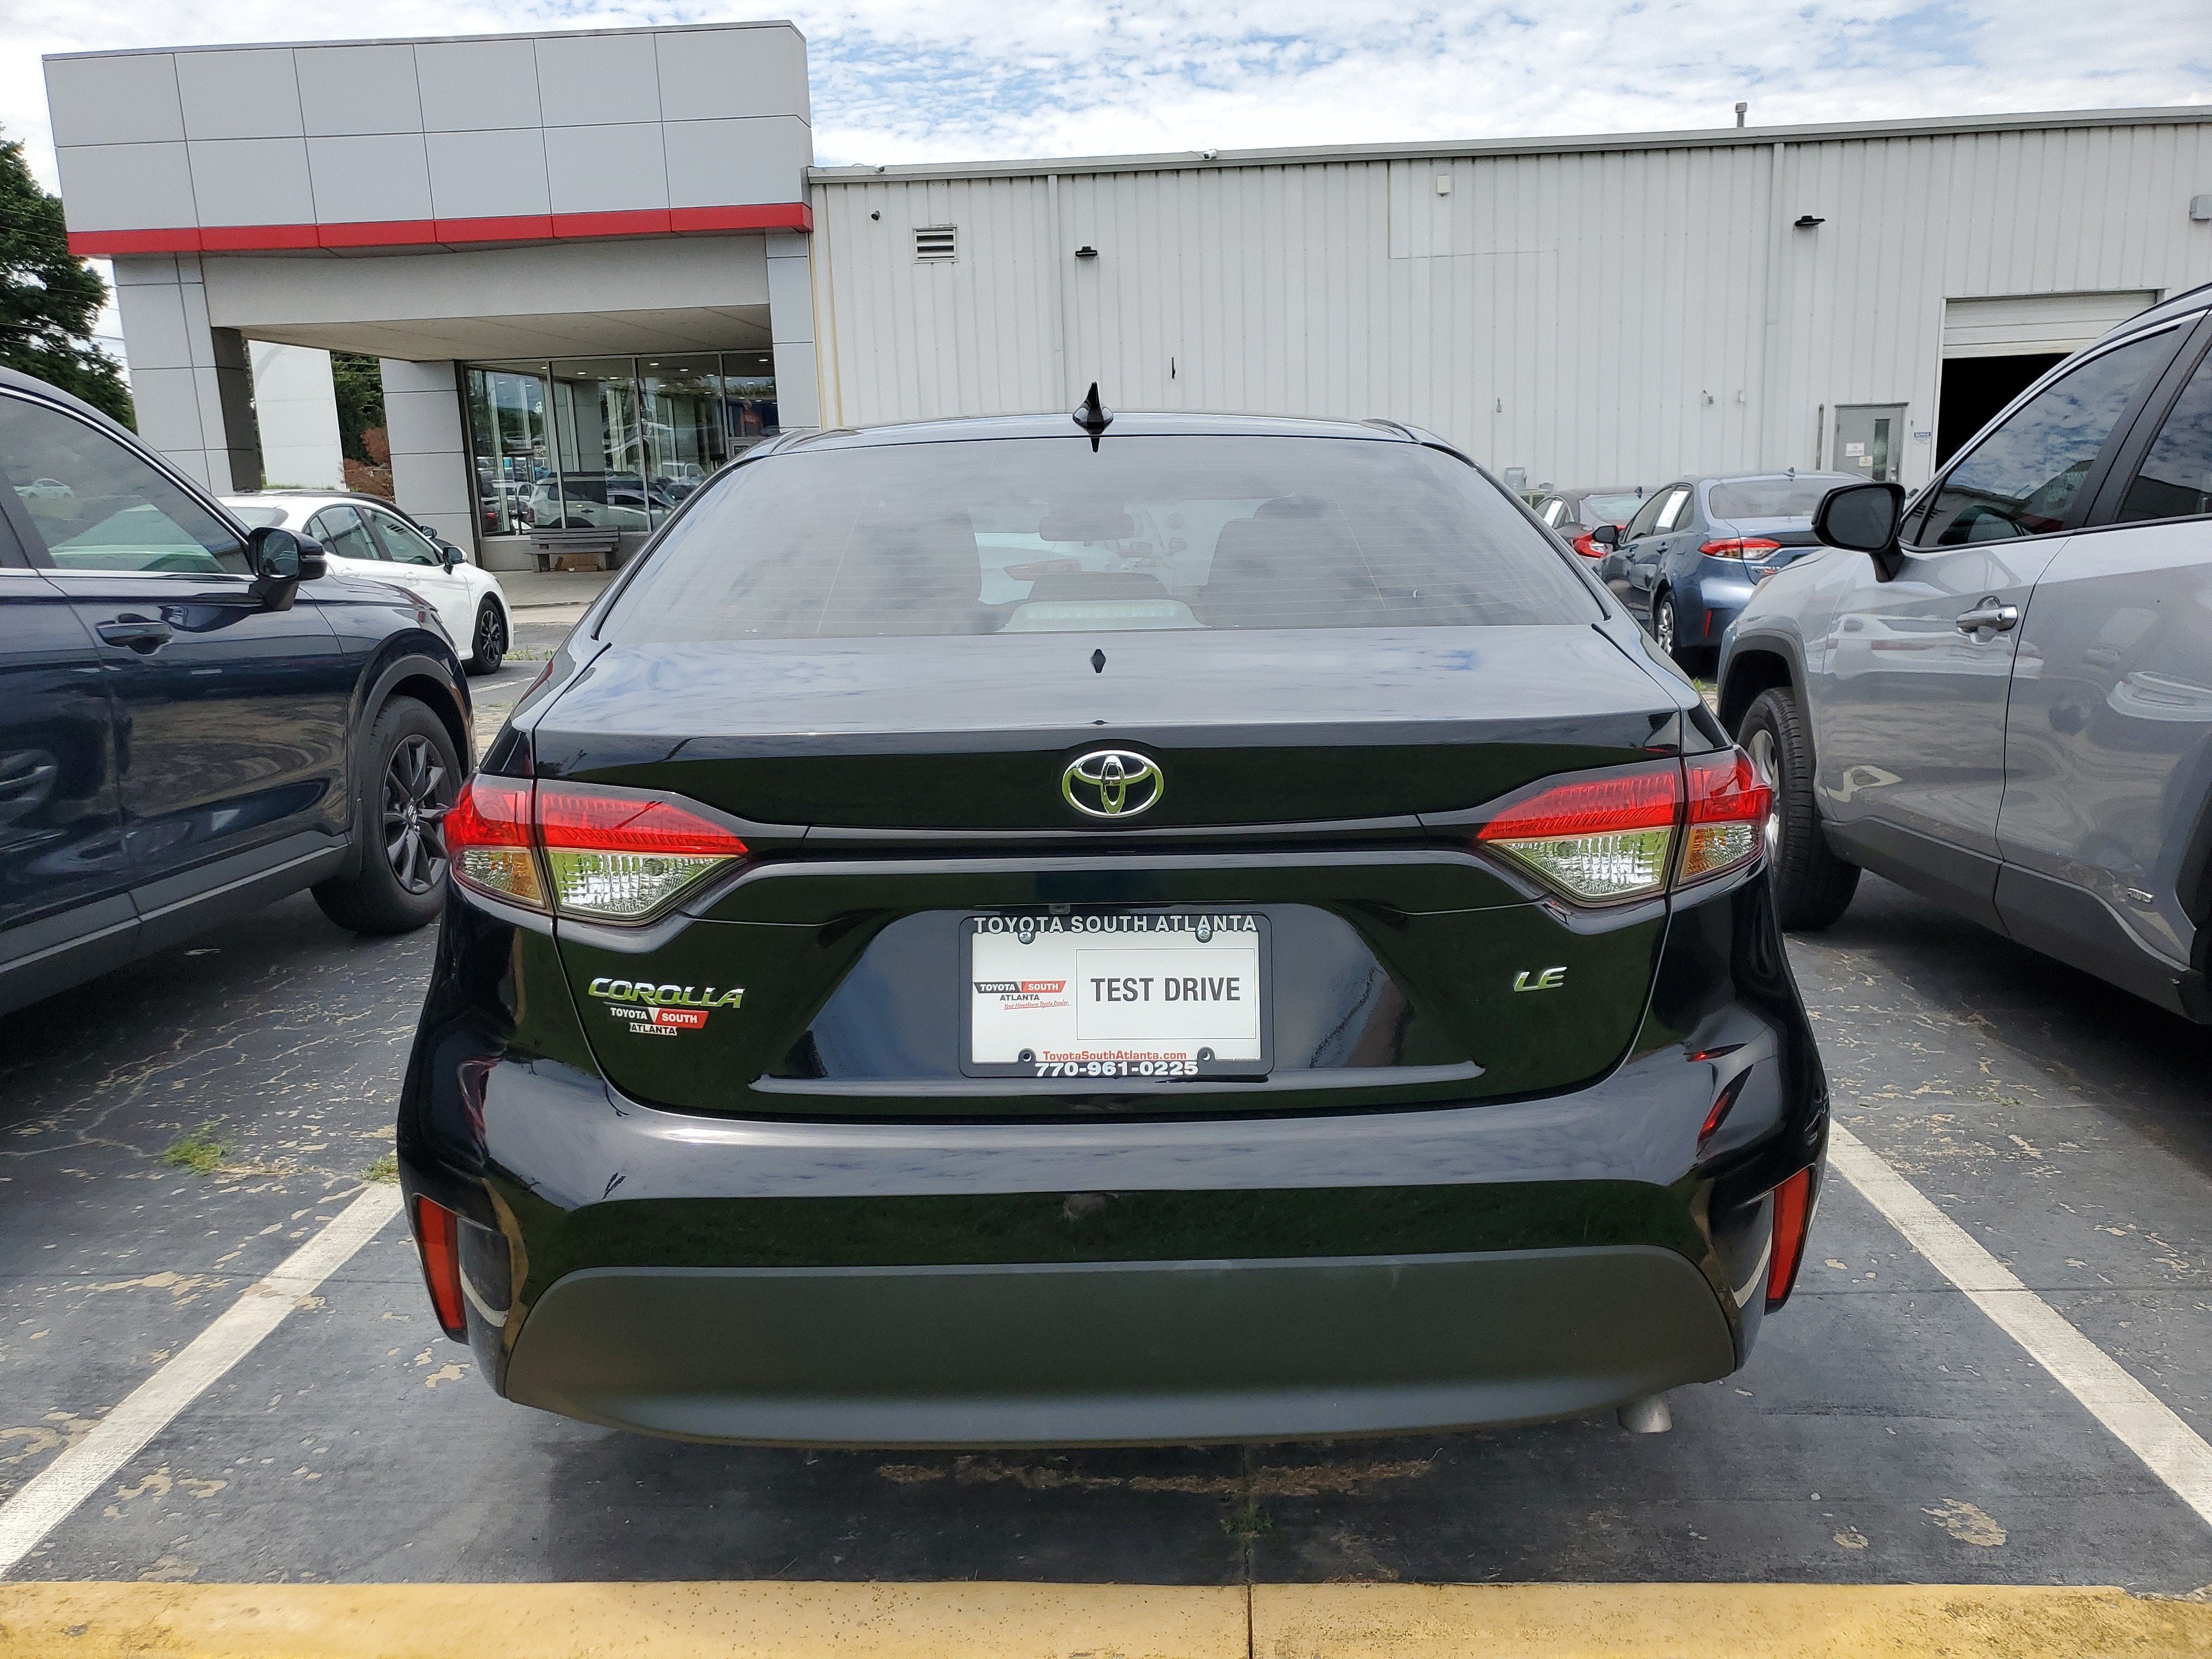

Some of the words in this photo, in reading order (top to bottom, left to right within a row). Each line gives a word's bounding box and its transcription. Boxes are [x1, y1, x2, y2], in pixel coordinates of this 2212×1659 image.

[974, 916, 1064, 933] TOYOTA
[1071, 916, 1148, 932] SOUTH
[1155, 915, 1257, 932] ATLANTA
[1514, 967, 1568, 992] LE
[588, 978, 745, 1008] COROLLA
[1090, 977, 1154, 1002] TEST
[1164, 977, 1241, 1001] DRIVE
[610, 1007, 648, 1020] TOYOTA
[662, 1013, 698, 1024] SOUTH
[630, 1024, 676, 1035] ATLANTA
[1043, 1050, 1187, 1061] ToyotaSouthAtlanta.com
[1035, 1061, 1199, 1076] 770-961-0225
